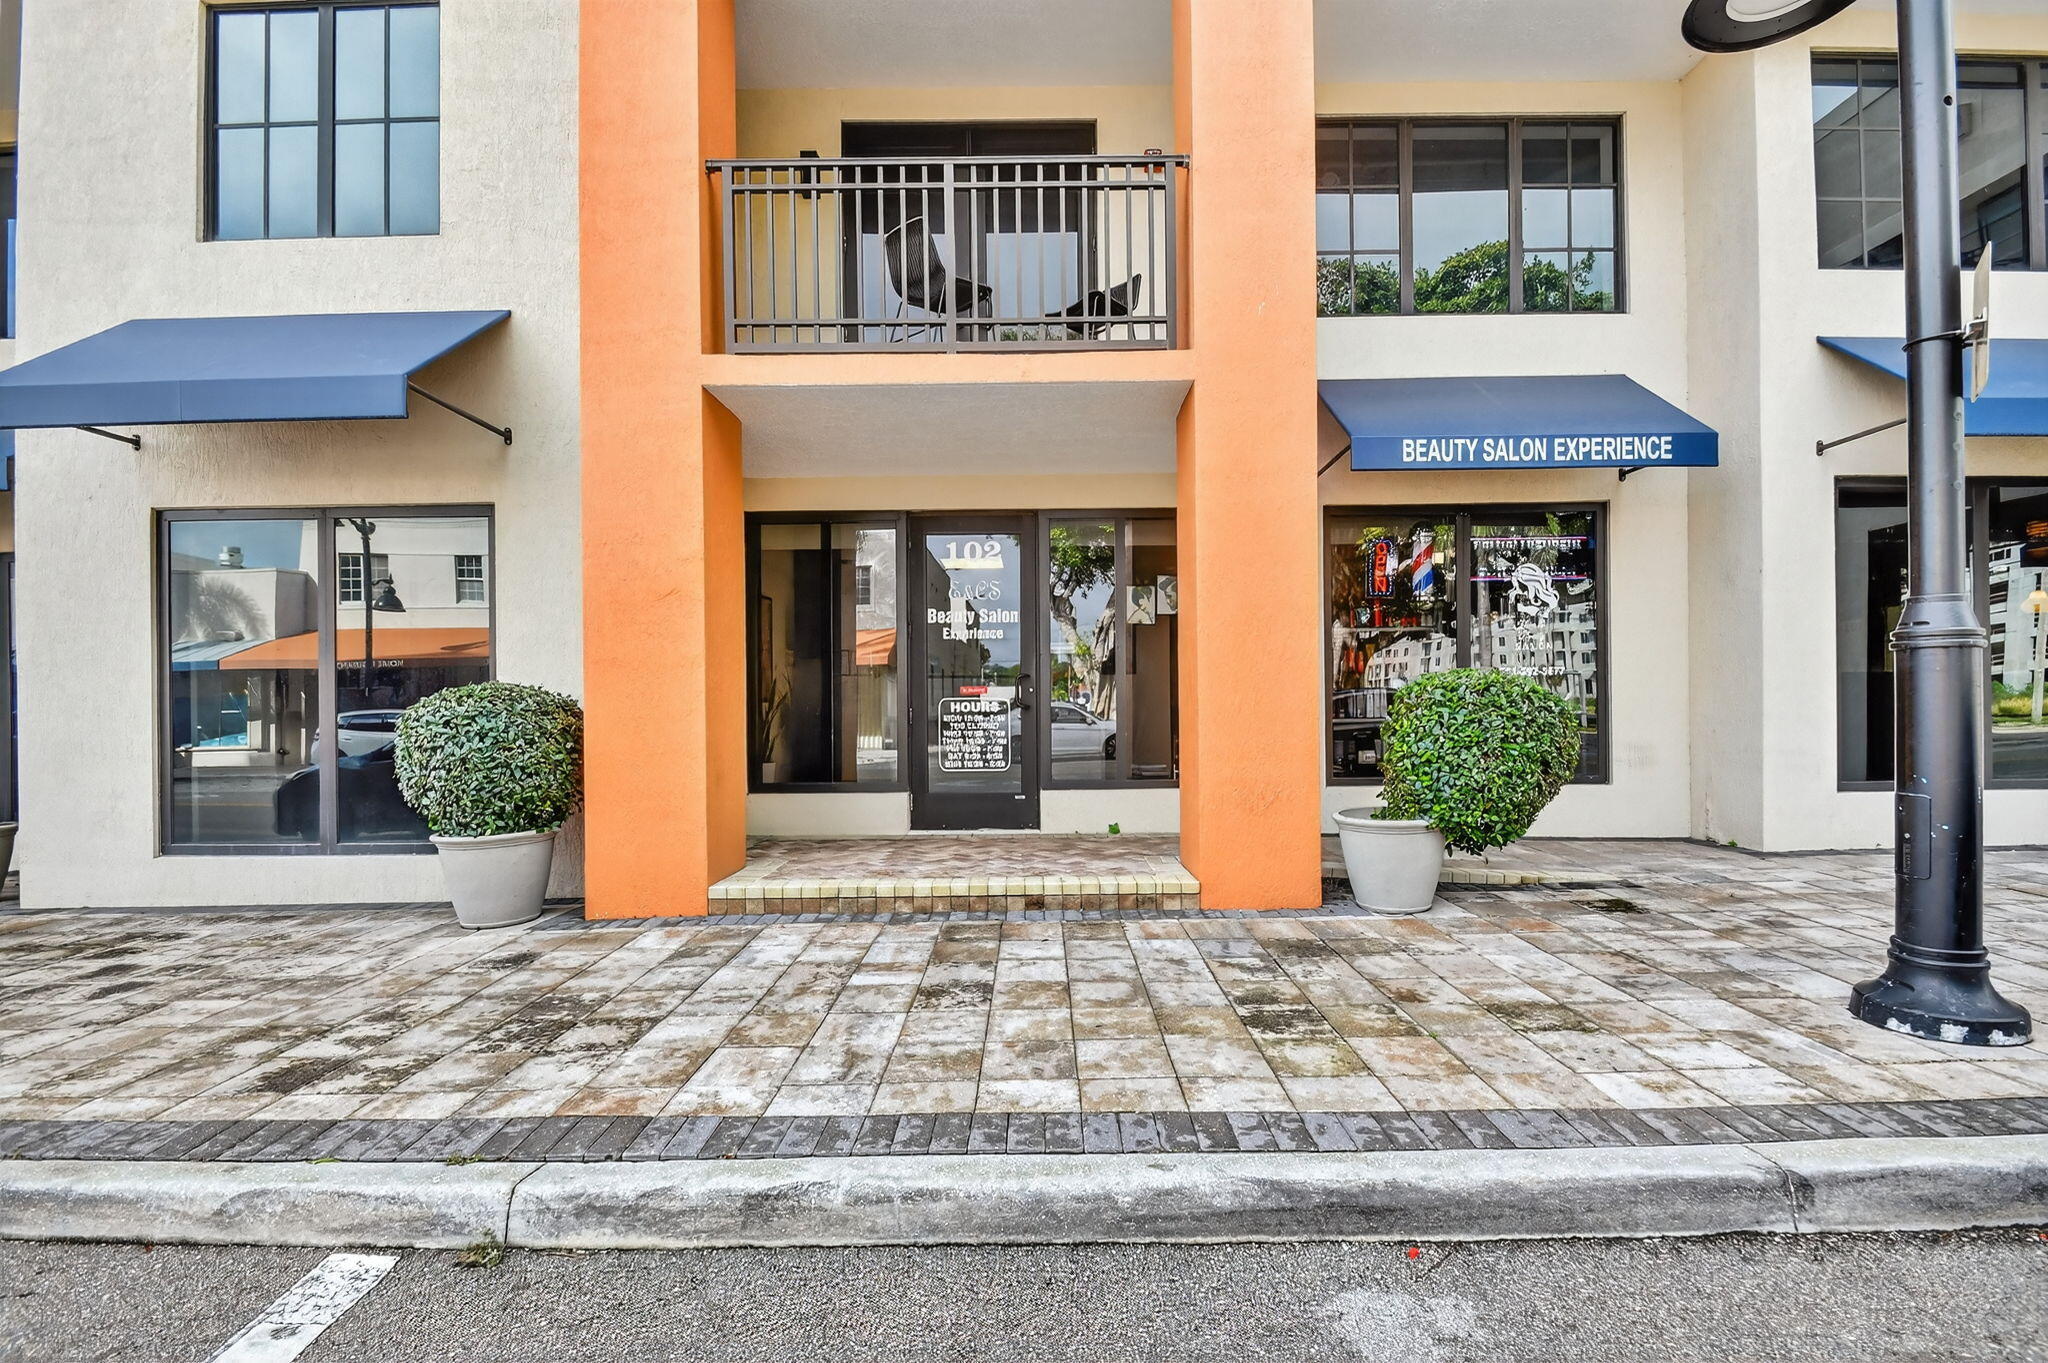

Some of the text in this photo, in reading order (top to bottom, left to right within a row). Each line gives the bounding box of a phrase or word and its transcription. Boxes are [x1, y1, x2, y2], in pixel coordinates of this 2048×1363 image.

[1402, 436, 1673, 462] BEAUTY SALON EXPERIENCE
[946, 541, 1001, 561] 102
[1374, 542, 1387, 592] OPEN
[927, 608, 1019, 625] Beauty Salon
[950, 701, 1000, 713] HOURS
